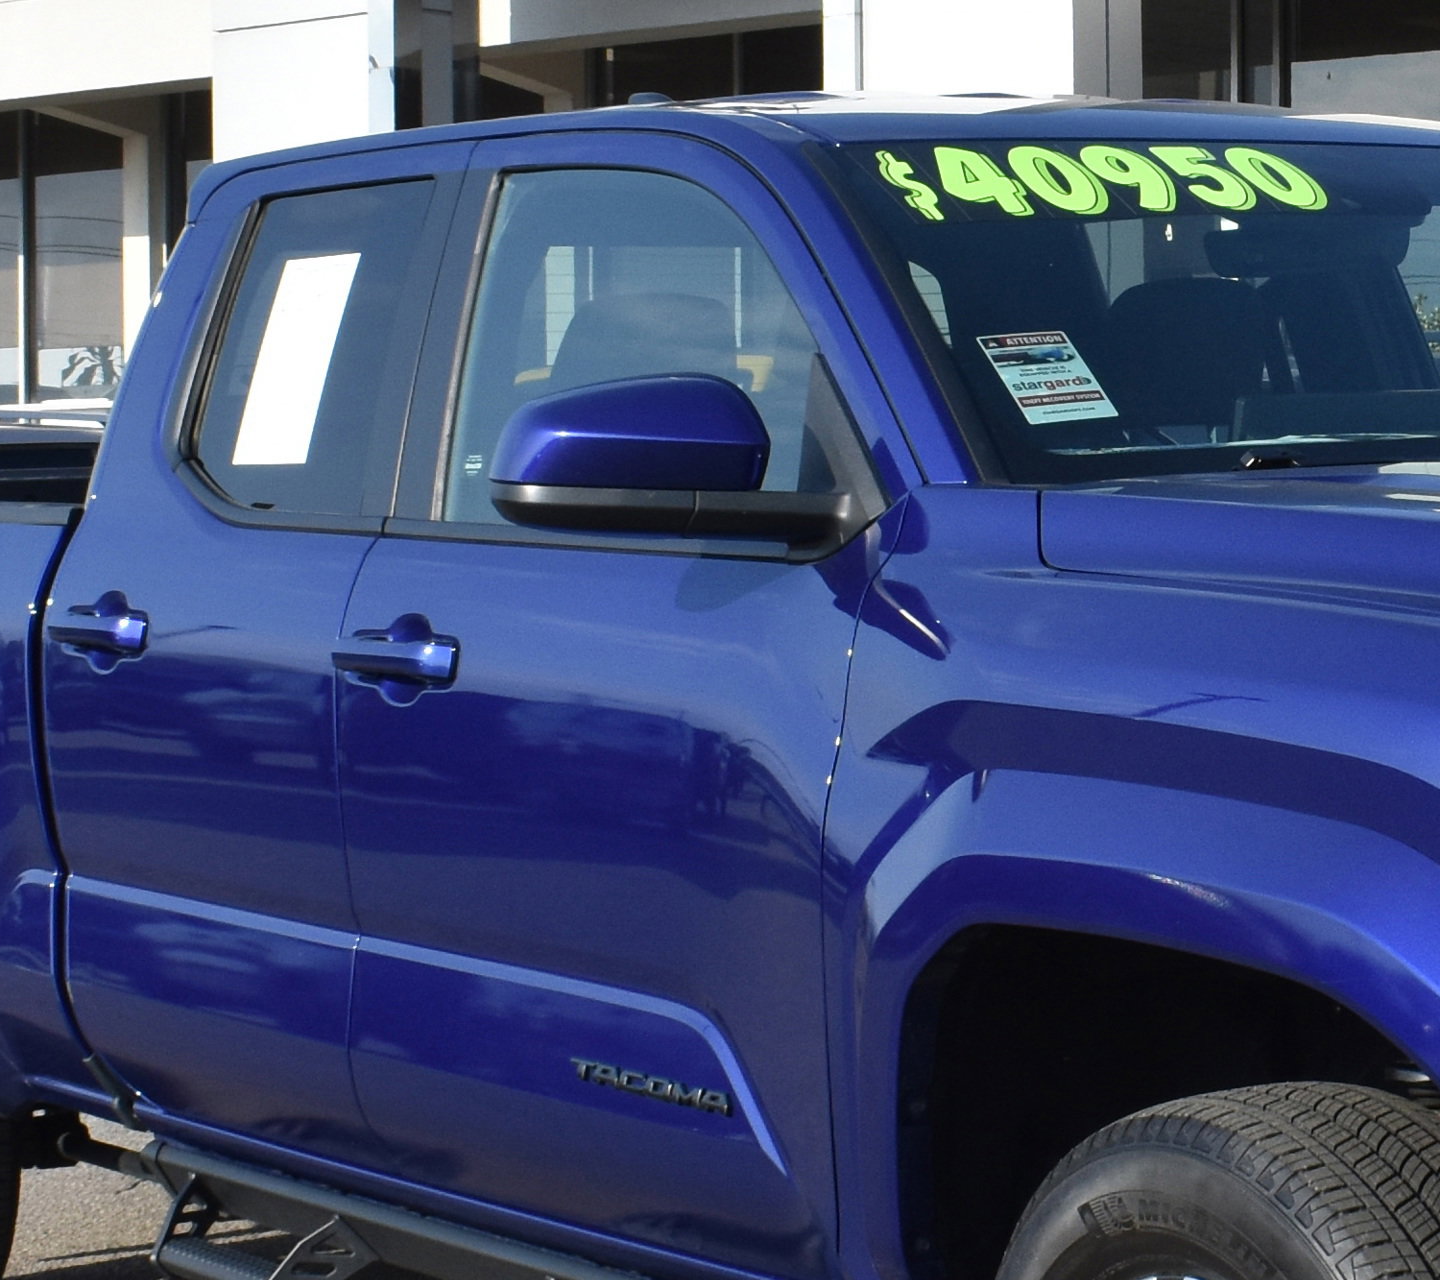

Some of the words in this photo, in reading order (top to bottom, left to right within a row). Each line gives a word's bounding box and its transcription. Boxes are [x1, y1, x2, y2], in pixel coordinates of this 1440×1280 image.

[875, 144, 1328, 221] $40950
[1006, 335, 1063, 346] ATTENTION
[1012, 376, 1082, 391] stargard
[570, 1057, 734, 1117] TACOMA
